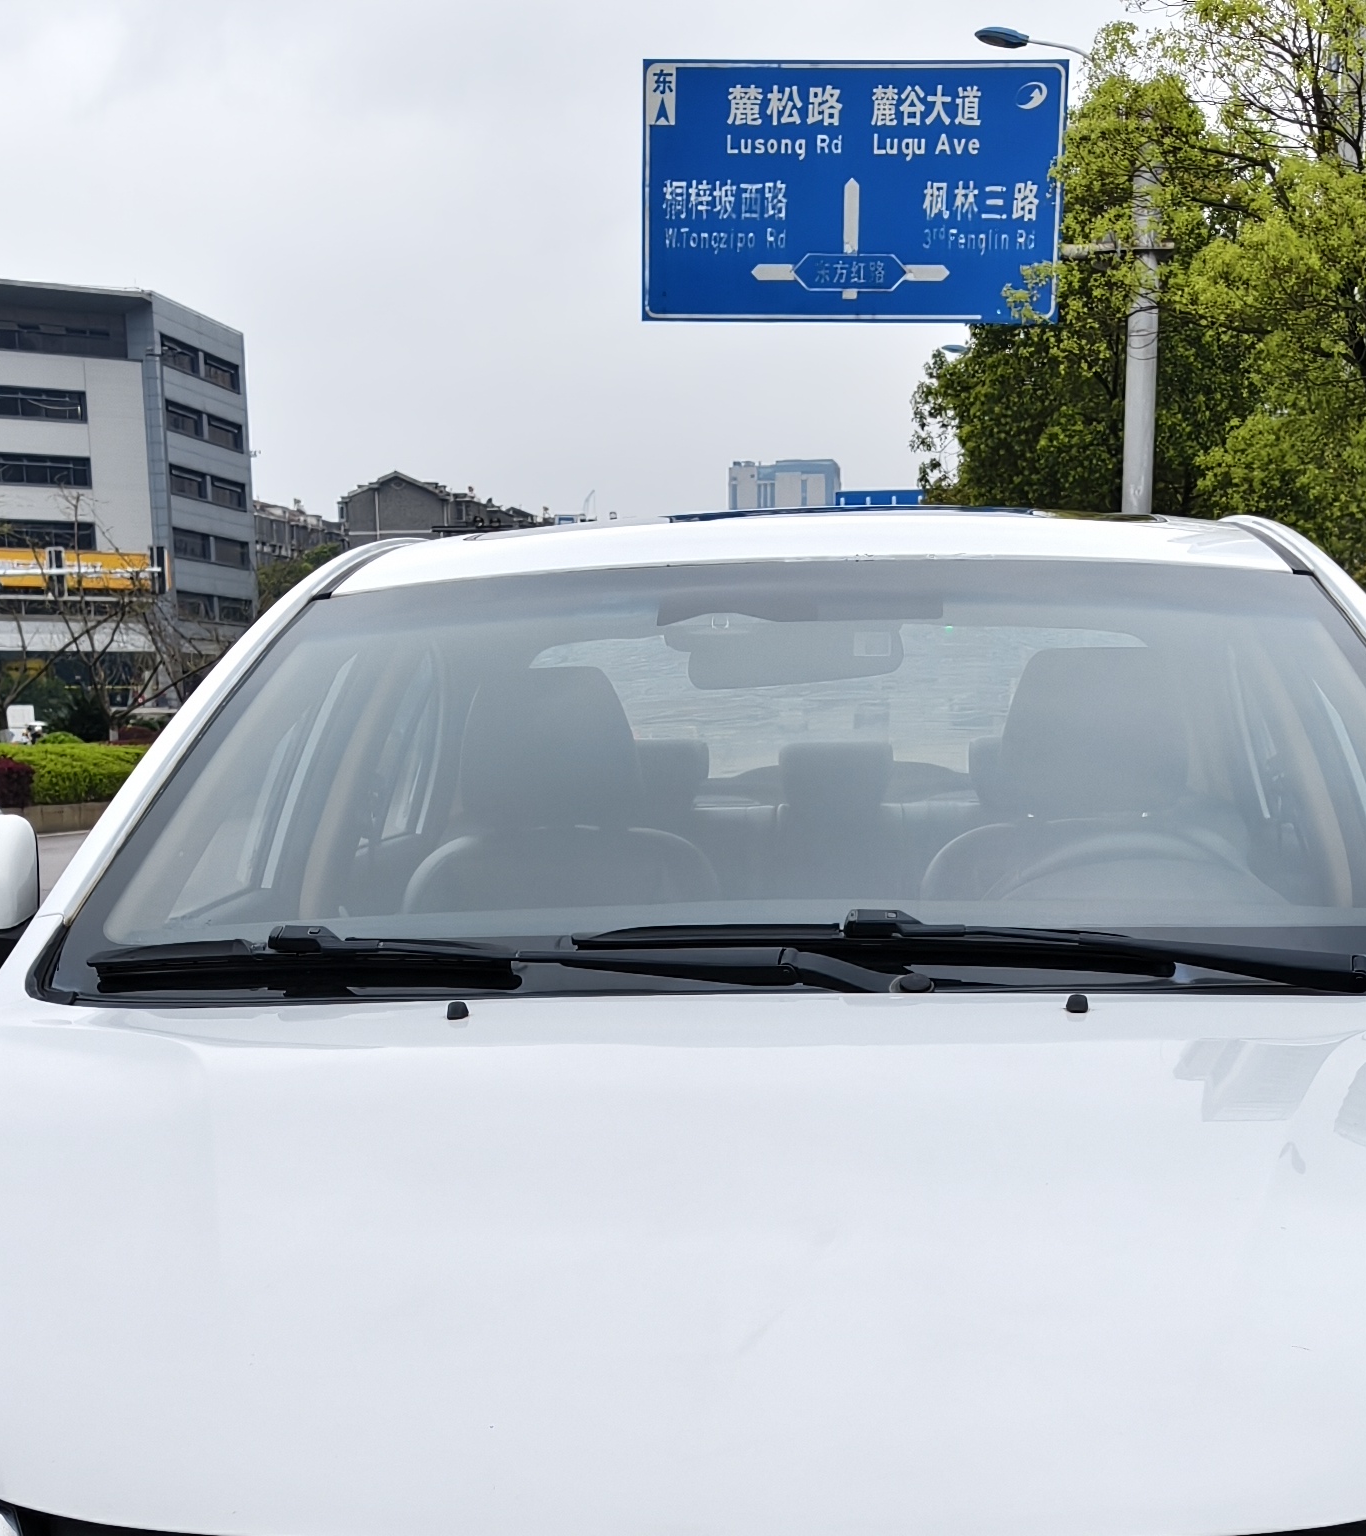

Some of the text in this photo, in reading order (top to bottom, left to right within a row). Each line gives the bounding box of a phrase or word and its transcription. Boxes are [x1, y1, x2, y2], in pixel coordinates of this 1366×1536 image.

[653, 70, 674, 93] 东
[727, 84, 843, 126] 麓松路
[870, 84, 982, 126] 麓谷大道
[727, 134, 842, 161] Lusong Rd
[873, 133, 980, 161] Lugu Ave
[922, 180, 1039, 221] 枫林三路
[766, 227, 786, 248] Rd
[1017, 229, 1035, 250] Rd
[815, 259, 885, 283] 东方红路
